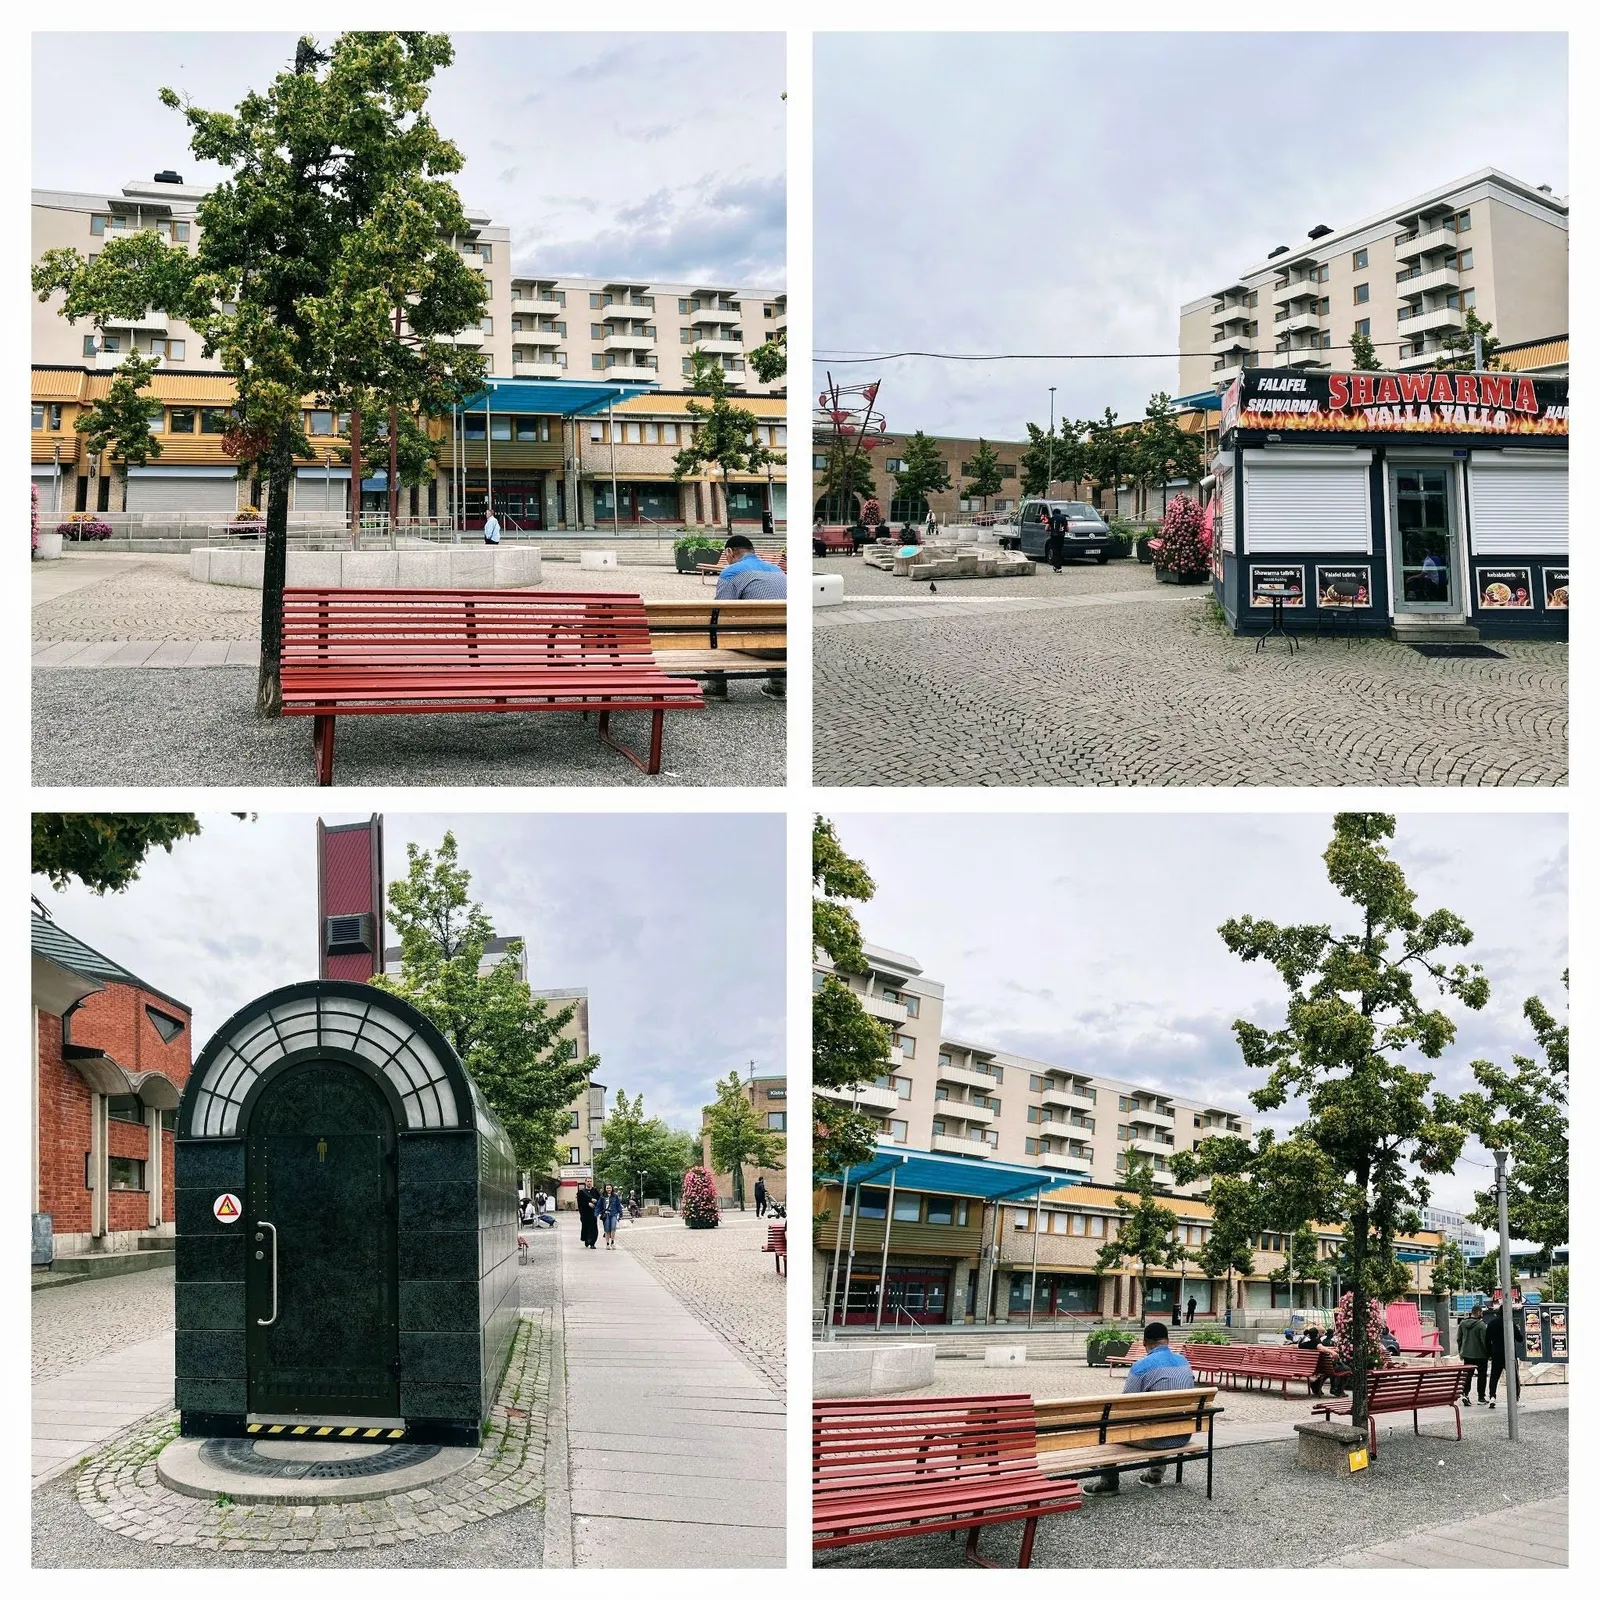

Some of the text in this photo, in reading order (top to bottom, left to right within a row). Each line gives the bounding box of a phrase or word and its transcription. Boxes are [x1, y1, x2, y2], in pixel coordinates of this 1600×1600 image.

[1257, 378, 1307, 392] FALAFEL
[1328, 373, 1538, 414] SHAWARMA
[1247, 398, 1319, 413] SHAWARMA
[1364, 404, 1508, 430] YALLA YALLA
